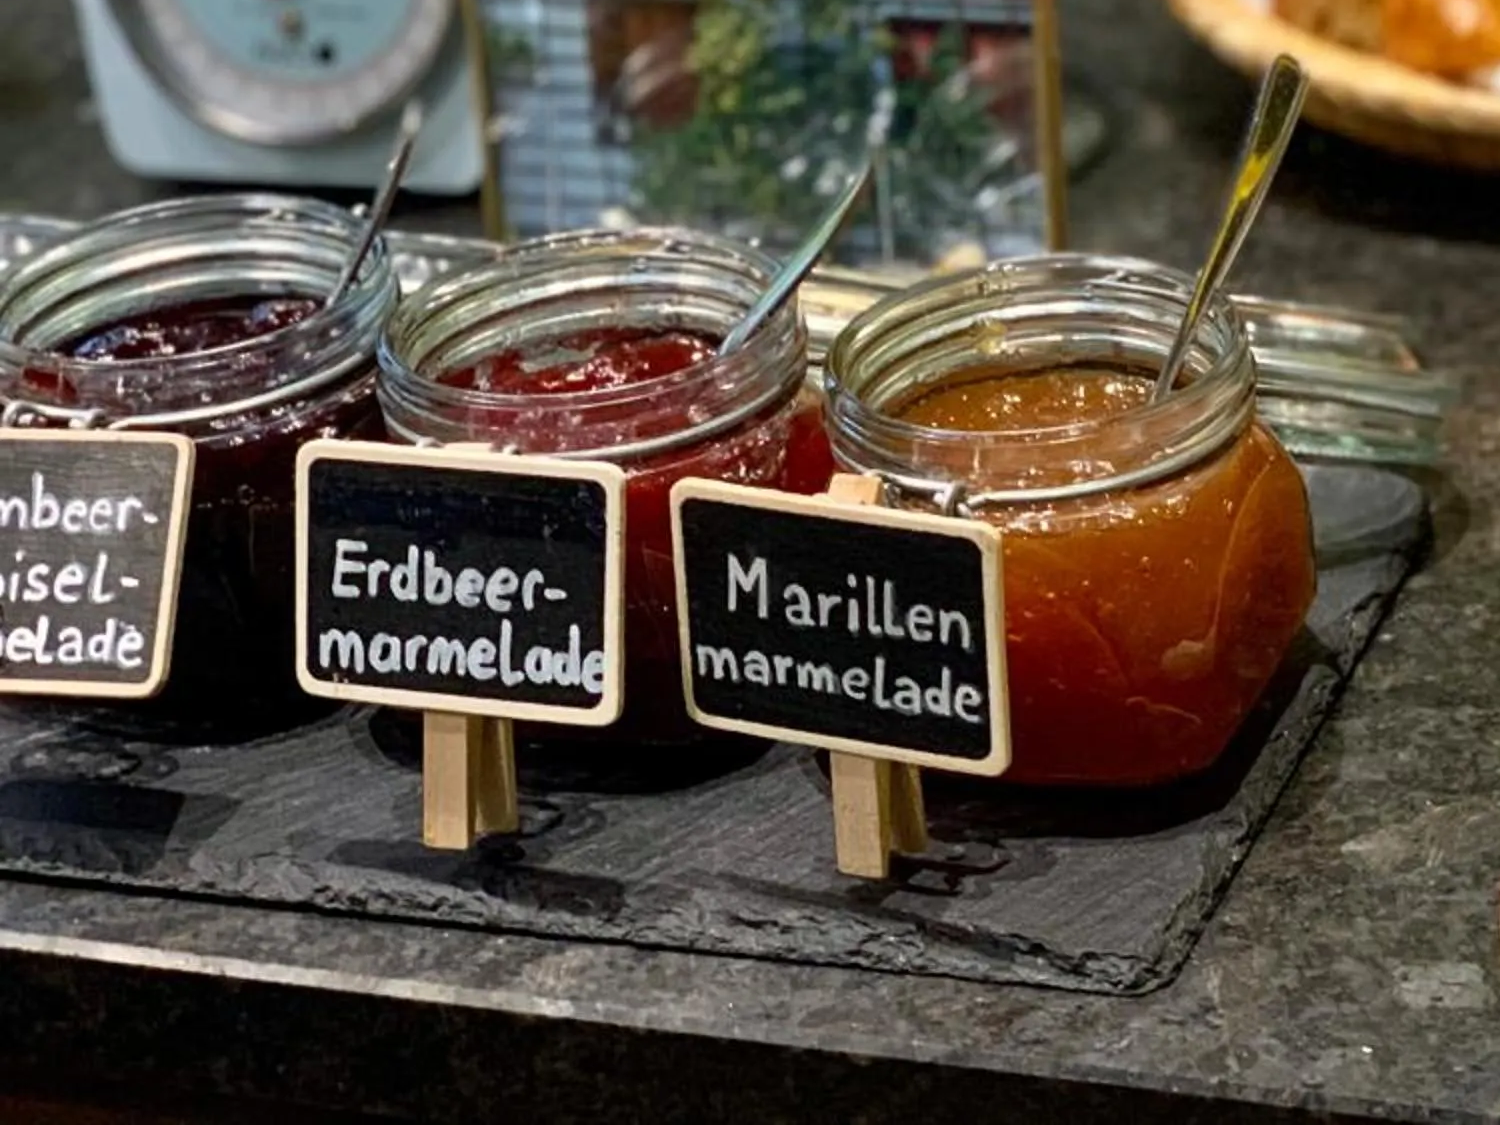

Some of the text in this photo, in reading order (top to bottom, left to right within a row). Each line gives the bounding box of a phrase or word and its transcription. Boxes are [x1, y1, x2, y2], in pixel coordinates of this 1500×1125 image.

[0, 549, 140, 605] isel-
[331, 538, 568, 612] Erdbeer-
[726, 552, 976, 652] Marillen
[0, 615, 145, 669] elade
[695, 643, 984, 724] marmelade
